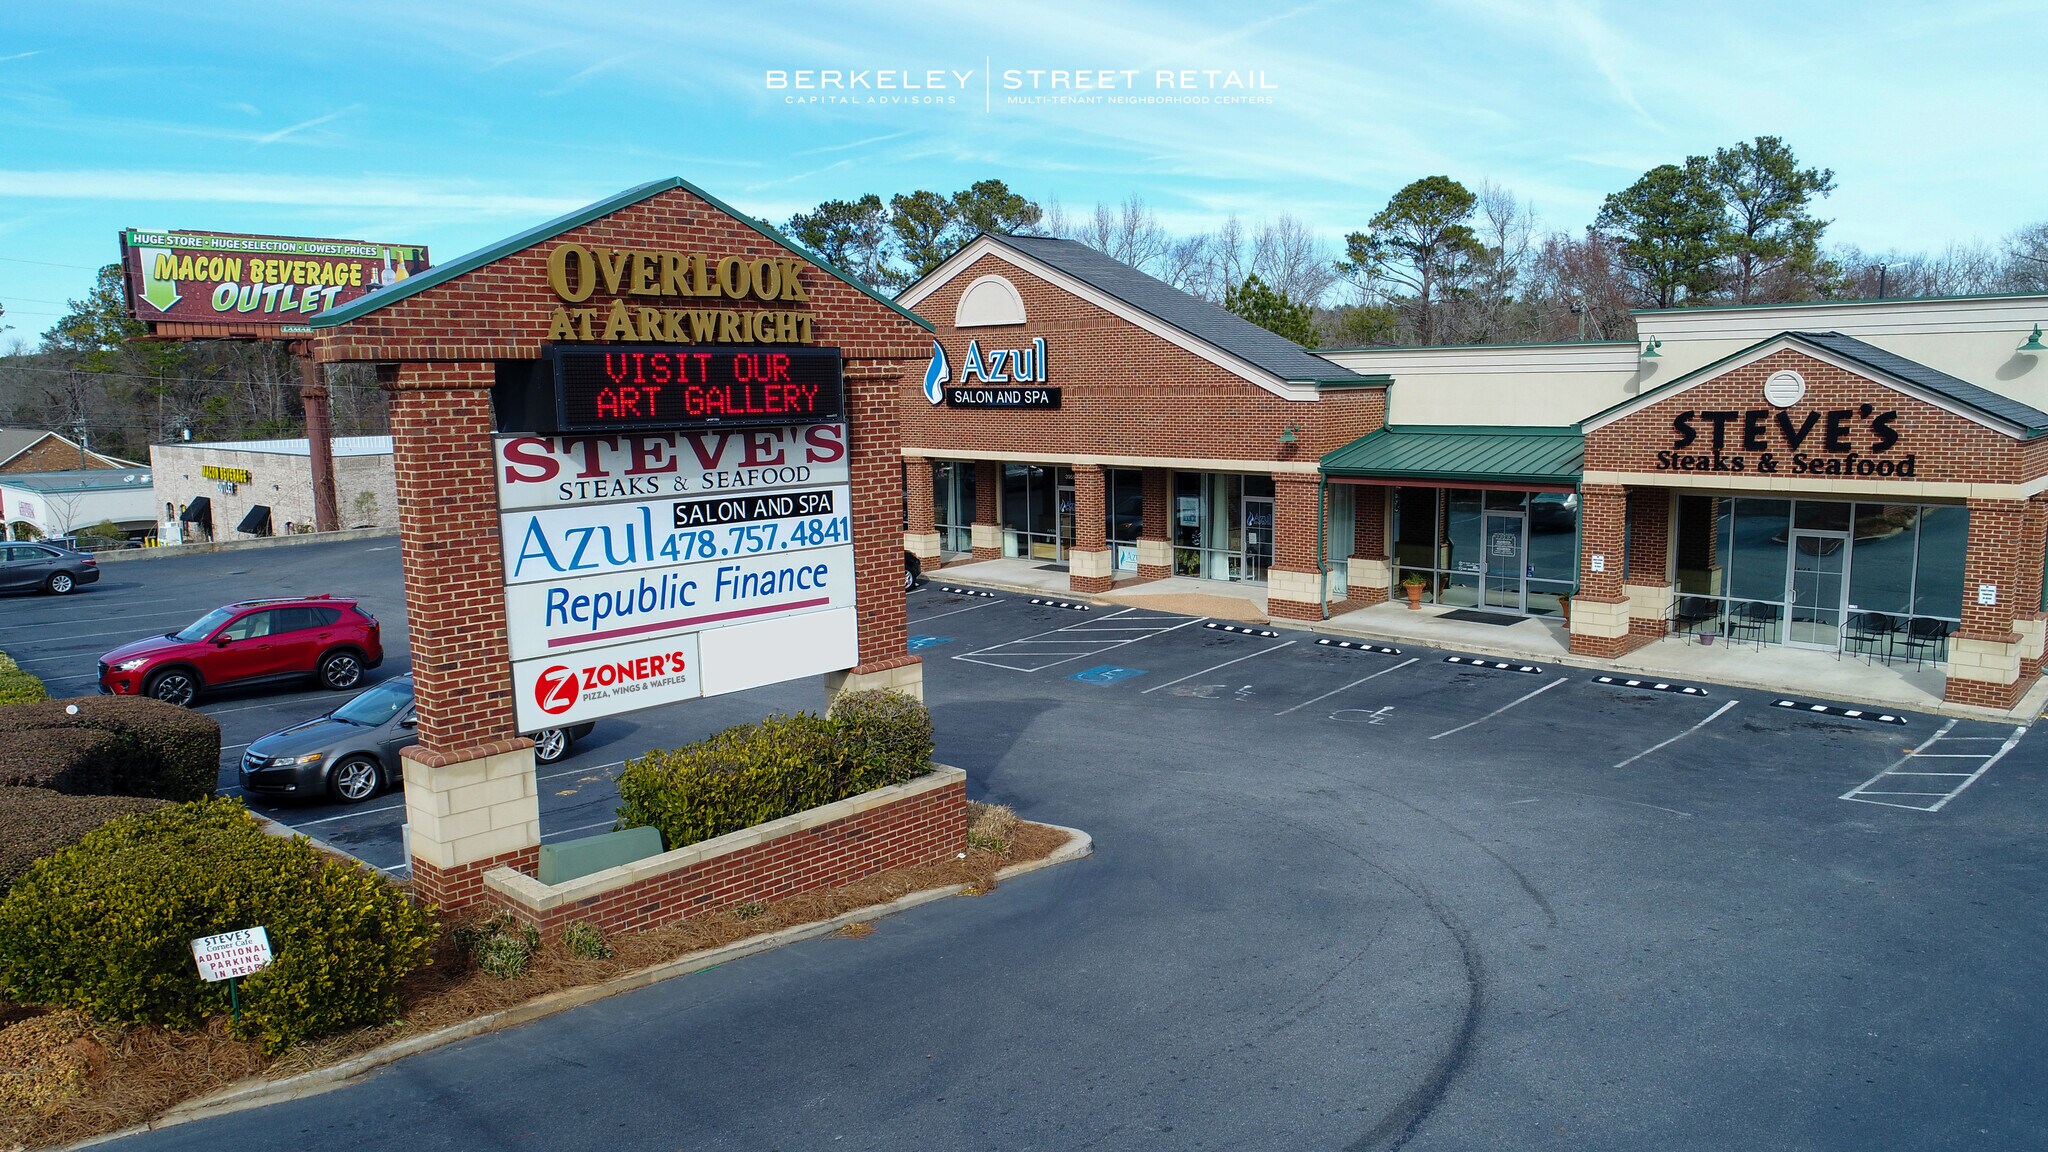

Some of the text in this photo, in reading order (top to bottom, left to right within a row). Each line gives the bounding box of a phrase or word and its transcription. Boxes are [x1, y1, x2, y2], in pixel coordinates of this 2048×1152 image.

[133, 233, 377, 256] HUGE STORE HUGE SELECTION LOWEST PRICES
[154, 253, 362, 287] MACON BEVERAGE
[547, 243, 810, 303] OVERLOOK
[211, 281, 343, 314] OUTLET
[546, 299, 816, 344] AT ARKWRIGHT
[605, 352, 791, 384] VISIT OUR
[961, 337, 1049, 383] Azul
[597, 384, 818, 418] ART GALLERY
[954, 390, 1049, 404] SALON AND SPA
[1673, 403, 1899, 454] STEVE'S
[503, 425, 845, 484] STEVE'S
[1656, 450, 1916, 478] Steaks & Seafood
[559, 465, 811, 501] STEAKS & SEAFOOD
[675, 494, 832, 526] SALON AND SPA
[514, 506, 654, 578] Azul
[660, 516, 849, 562] 478.757.4841
[545, 563, 828, 631] Republic Finance
[582, 651, 686, 690] ZONER'S
[583, 676, 686, 701] PIZZA, WINGS & WAFFLES
[199, 944, 266, 962] ADDITIONAL
[205, 931, 251, 946] STEVE'S
[206, 939, 253, 952] Corner Cafe
[210, 954, 260, 970] PARKING
[215, 964, 262, 978] IN REAR
